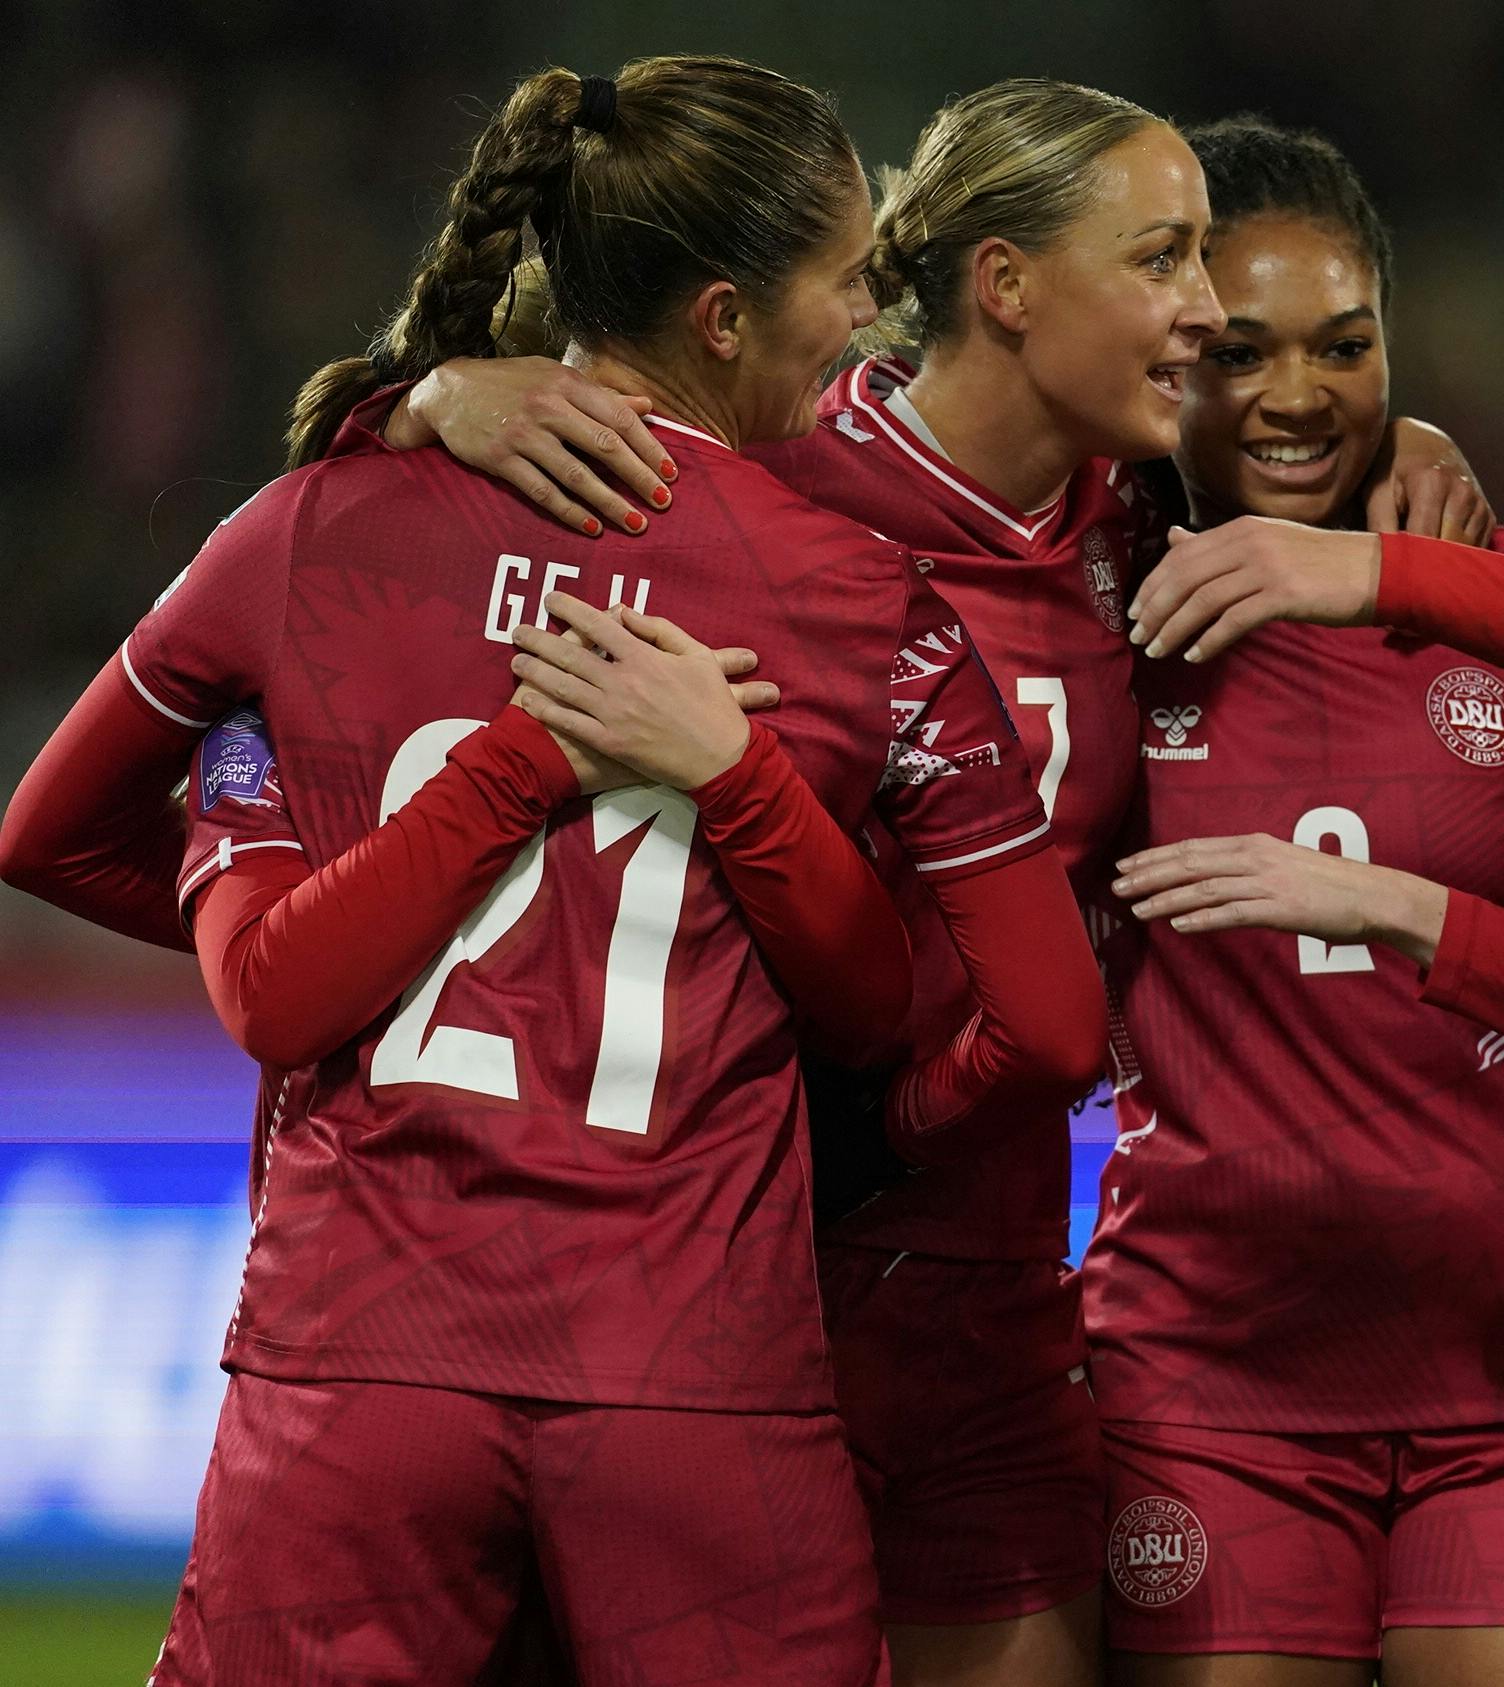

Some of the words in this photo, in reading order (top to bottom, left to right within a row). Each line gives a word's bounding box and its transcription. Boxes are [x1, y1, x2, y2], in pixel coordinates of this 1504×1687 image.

[1016, 677, 1071, 822] 7
[1140, 743, 1209, 760] hummel
[1430, 692, 1461, 748] DANSK
[1464, 748, 1502, 763] 1889
[206, 763, 258, 787] NATIONS
[208, 774, 253, 796] LEAGUE
[1293, 806, 1376, 975] 2
[369, 717, 700, 1136] 21
[1111, 1533, 1135, 1594] DANSK
[1128, 1533, 1185, 1566] DBU
[1181, 1528, 1203, 1588] UNION
[1139, 1586, 1178, 1603] 1889
